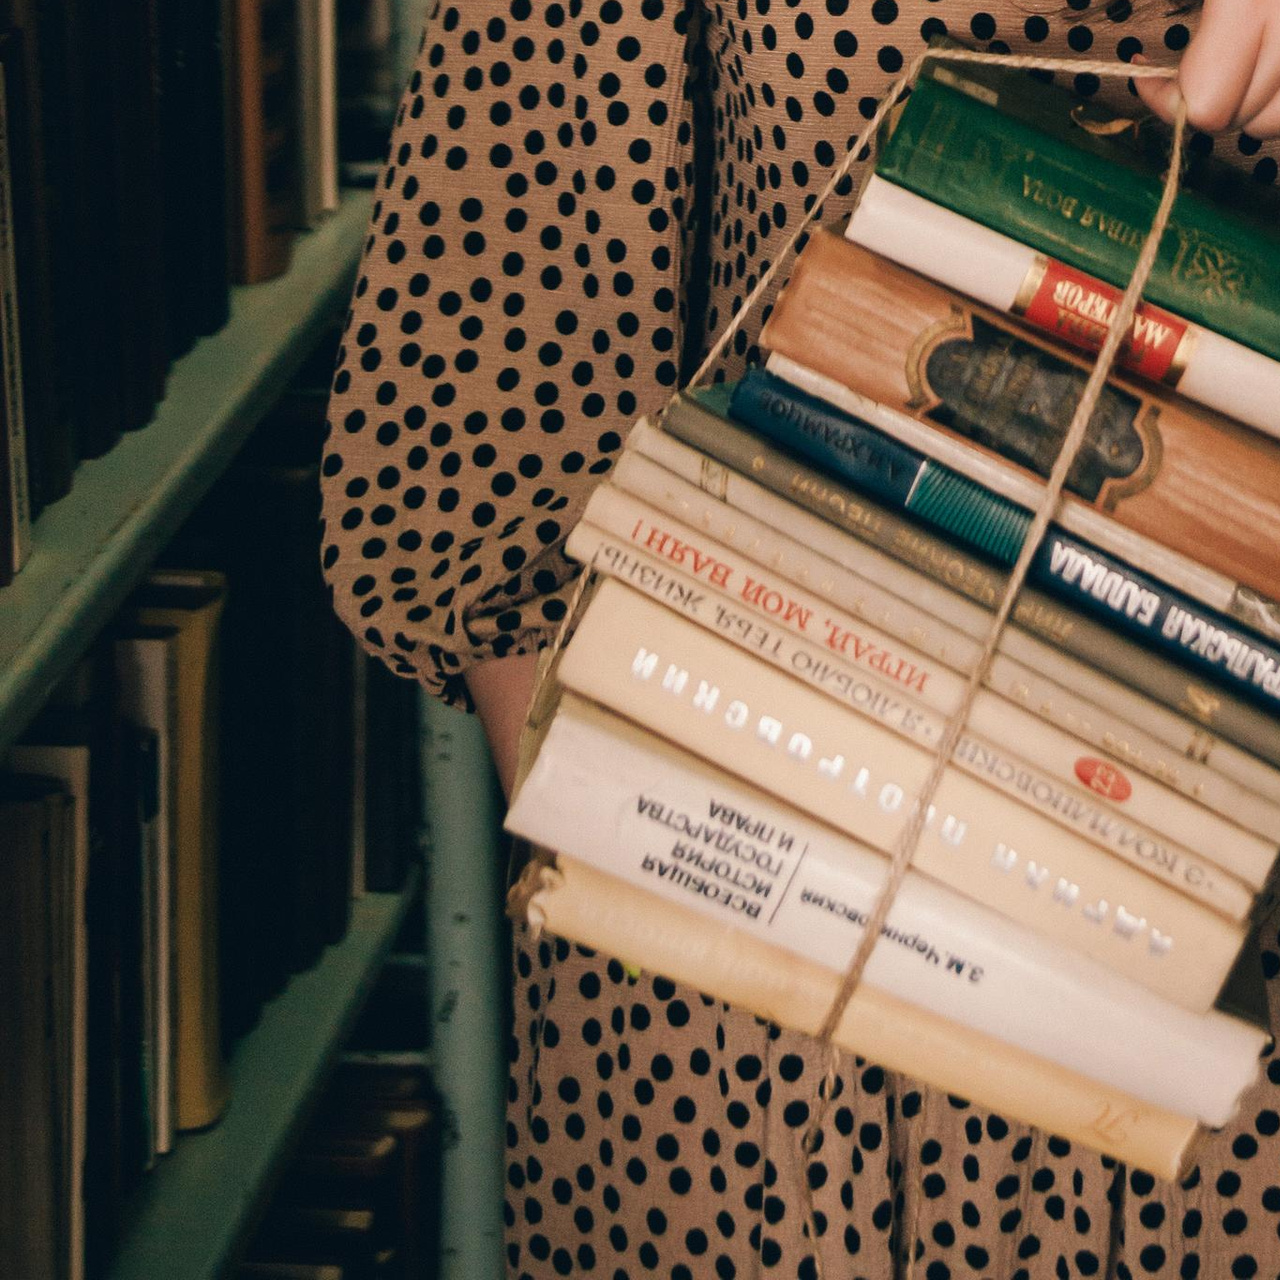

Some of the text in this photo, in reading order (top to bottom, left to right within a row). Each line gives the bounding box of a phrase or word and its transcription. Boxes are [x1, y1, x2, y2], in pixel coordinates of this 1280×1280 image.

[1049, 279, 1172, 349] МАТЕРОВ
[1043, 541, 1161, 625] БАЛЛАДА
[789, 650, 898, 721] ЛЮБЛЮ
[633, 794, 783, 873] ГОСУДАРСТВА
[704, 799, 794, 849] И ПРАВА
[640, 853, 761, 918] ВСЕОБЩАЯ
[671, 840, 771, 895] ИСТОРИЯ
